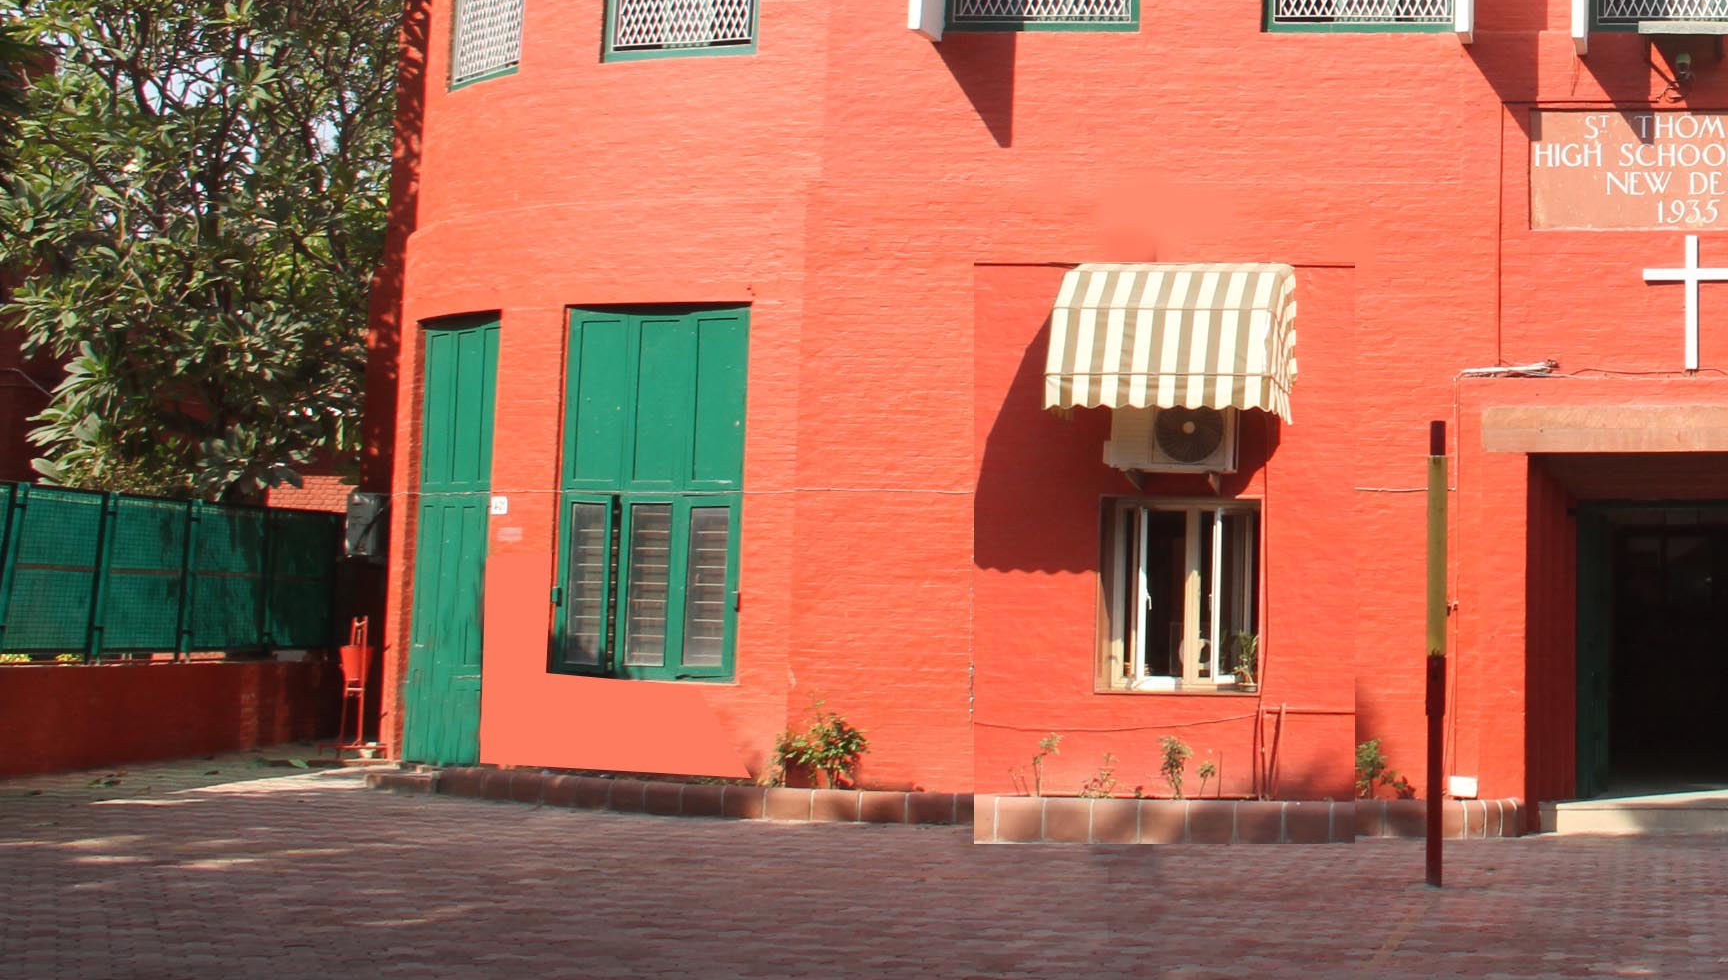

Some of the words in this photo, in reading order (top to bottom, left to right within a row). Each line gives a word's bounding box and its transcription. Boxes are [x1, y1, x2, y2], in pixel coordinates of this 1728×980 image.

[1534, 143, 1602, 168] HIGH
[1606, 171, 1673, 196] NEW
[1657, 199, 1721, 224] 1935
